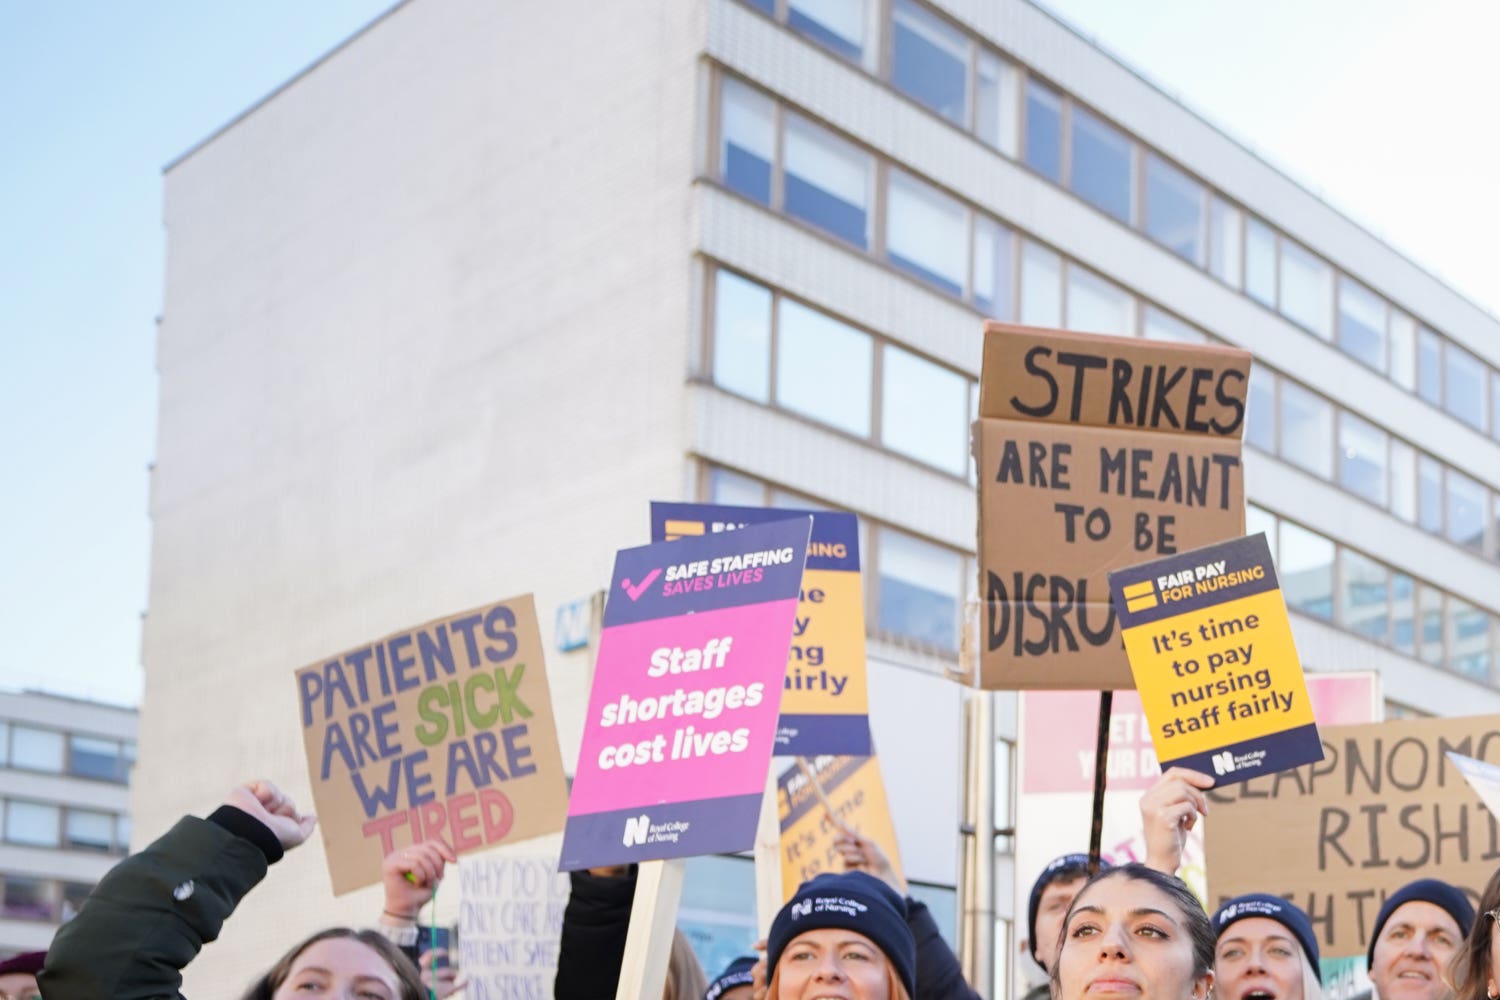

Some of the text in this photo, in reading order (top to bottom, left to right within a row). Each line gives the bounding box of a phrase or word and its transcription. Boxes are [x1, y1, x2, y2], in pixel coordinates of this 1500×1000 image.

[1009, 346, 1245, 435] STRIKES
[996, 440, 1239, 510] ARE MEANT
[1054, 502, 1177, 555] TO BE
[662, 567, 764, 597] SAVES LIVES
[665, 547, 794, 582] SAFE STAFFING
[1157, 560, 1226, 590] FAIR PAY
[1161, 565, 1266, 605] FOR NURSING
[986, 570, 1126, 657] DISRU
[1152, 614, 1260, 655] It's time
[300, 605, 518, 728] PATIENTS
[648, 636, 733, 678] Staff
[1172, 643, 1254, 677] to pay
[600, 682, 765, 728] shortages
[1171, 667, 1272, 707] nursing
[320, 664, 534, 781] ARE SICK
[1162, 707, 1221, 739] staff
[1228, 690, 1294, 722] fairly
[351, 724, 536, 818] WE ARE
[598, 726, 750, 770] cost lives
[1345, 737, 1429, 795] NO
[362, 789, 514, 859] TIRED
[542, 858, 571, 895] YO
